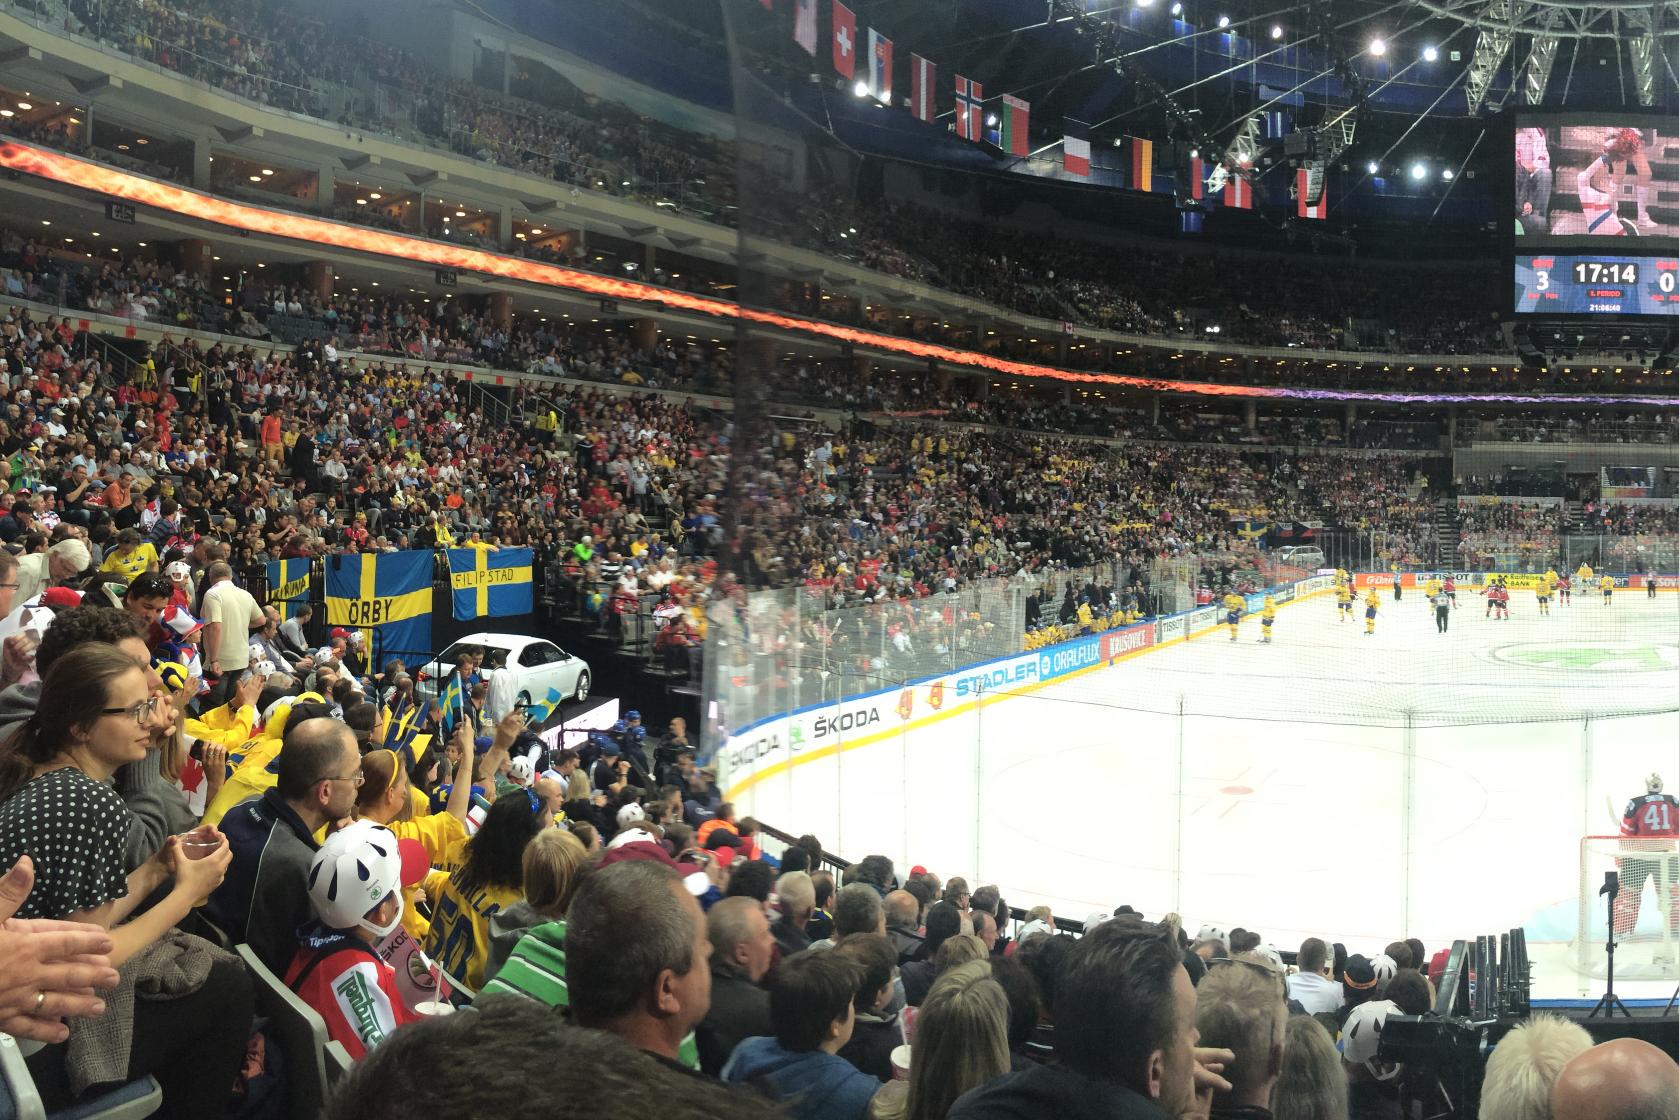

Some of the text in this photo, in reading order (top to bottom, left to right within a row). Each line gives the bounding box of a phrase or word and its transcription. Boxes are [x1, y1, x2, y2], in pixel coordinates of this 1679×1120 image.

[1536, 270, 1549, 291] 3
[1575, 263, 1636, 283] 17:14
[1659, 272, 1675, 293] 0
[455, 568, 514, 589] FILIPSTAD
[348, 598, 393, 624] ÖRBY
[956, 660, 1038, 697] STADLER
[814, 707, 881, 739] ŠKODA
[1644, 803, 1671, 831] 41
[380, 930, 409, 961] ŠKOD
